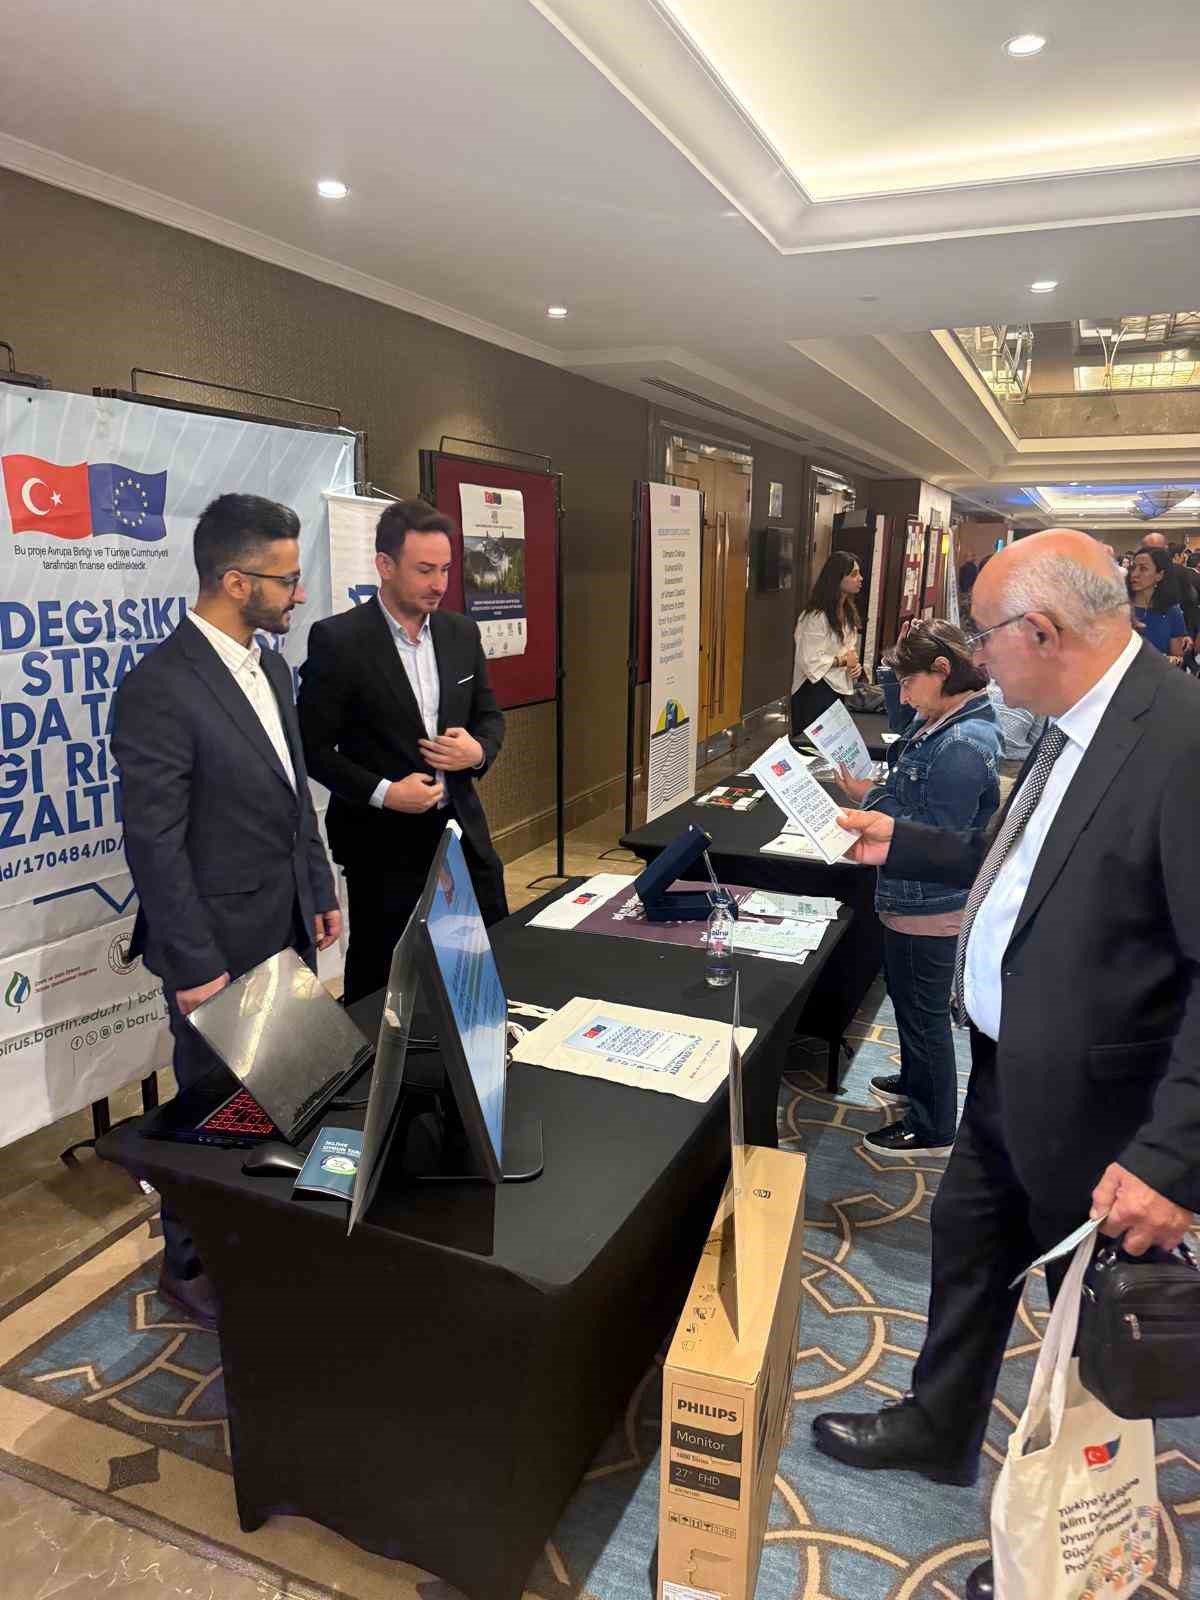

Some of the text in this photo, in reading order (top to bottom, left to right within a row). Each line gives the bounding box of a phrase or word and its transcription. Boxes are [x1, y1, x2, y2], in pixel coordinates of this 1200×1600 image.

[14, 545, 26, 556] Bu
[27, 547, 46, 559] proje
[66, 739, 121, 788] Rİ
[677, 1399, 737, 1422] PHILIPS
[676, 1430, 726, 1451] Monitor
[698, 1473, 720, 1486] FHD
[1061, 1531, 1095, 1545] Uyum
